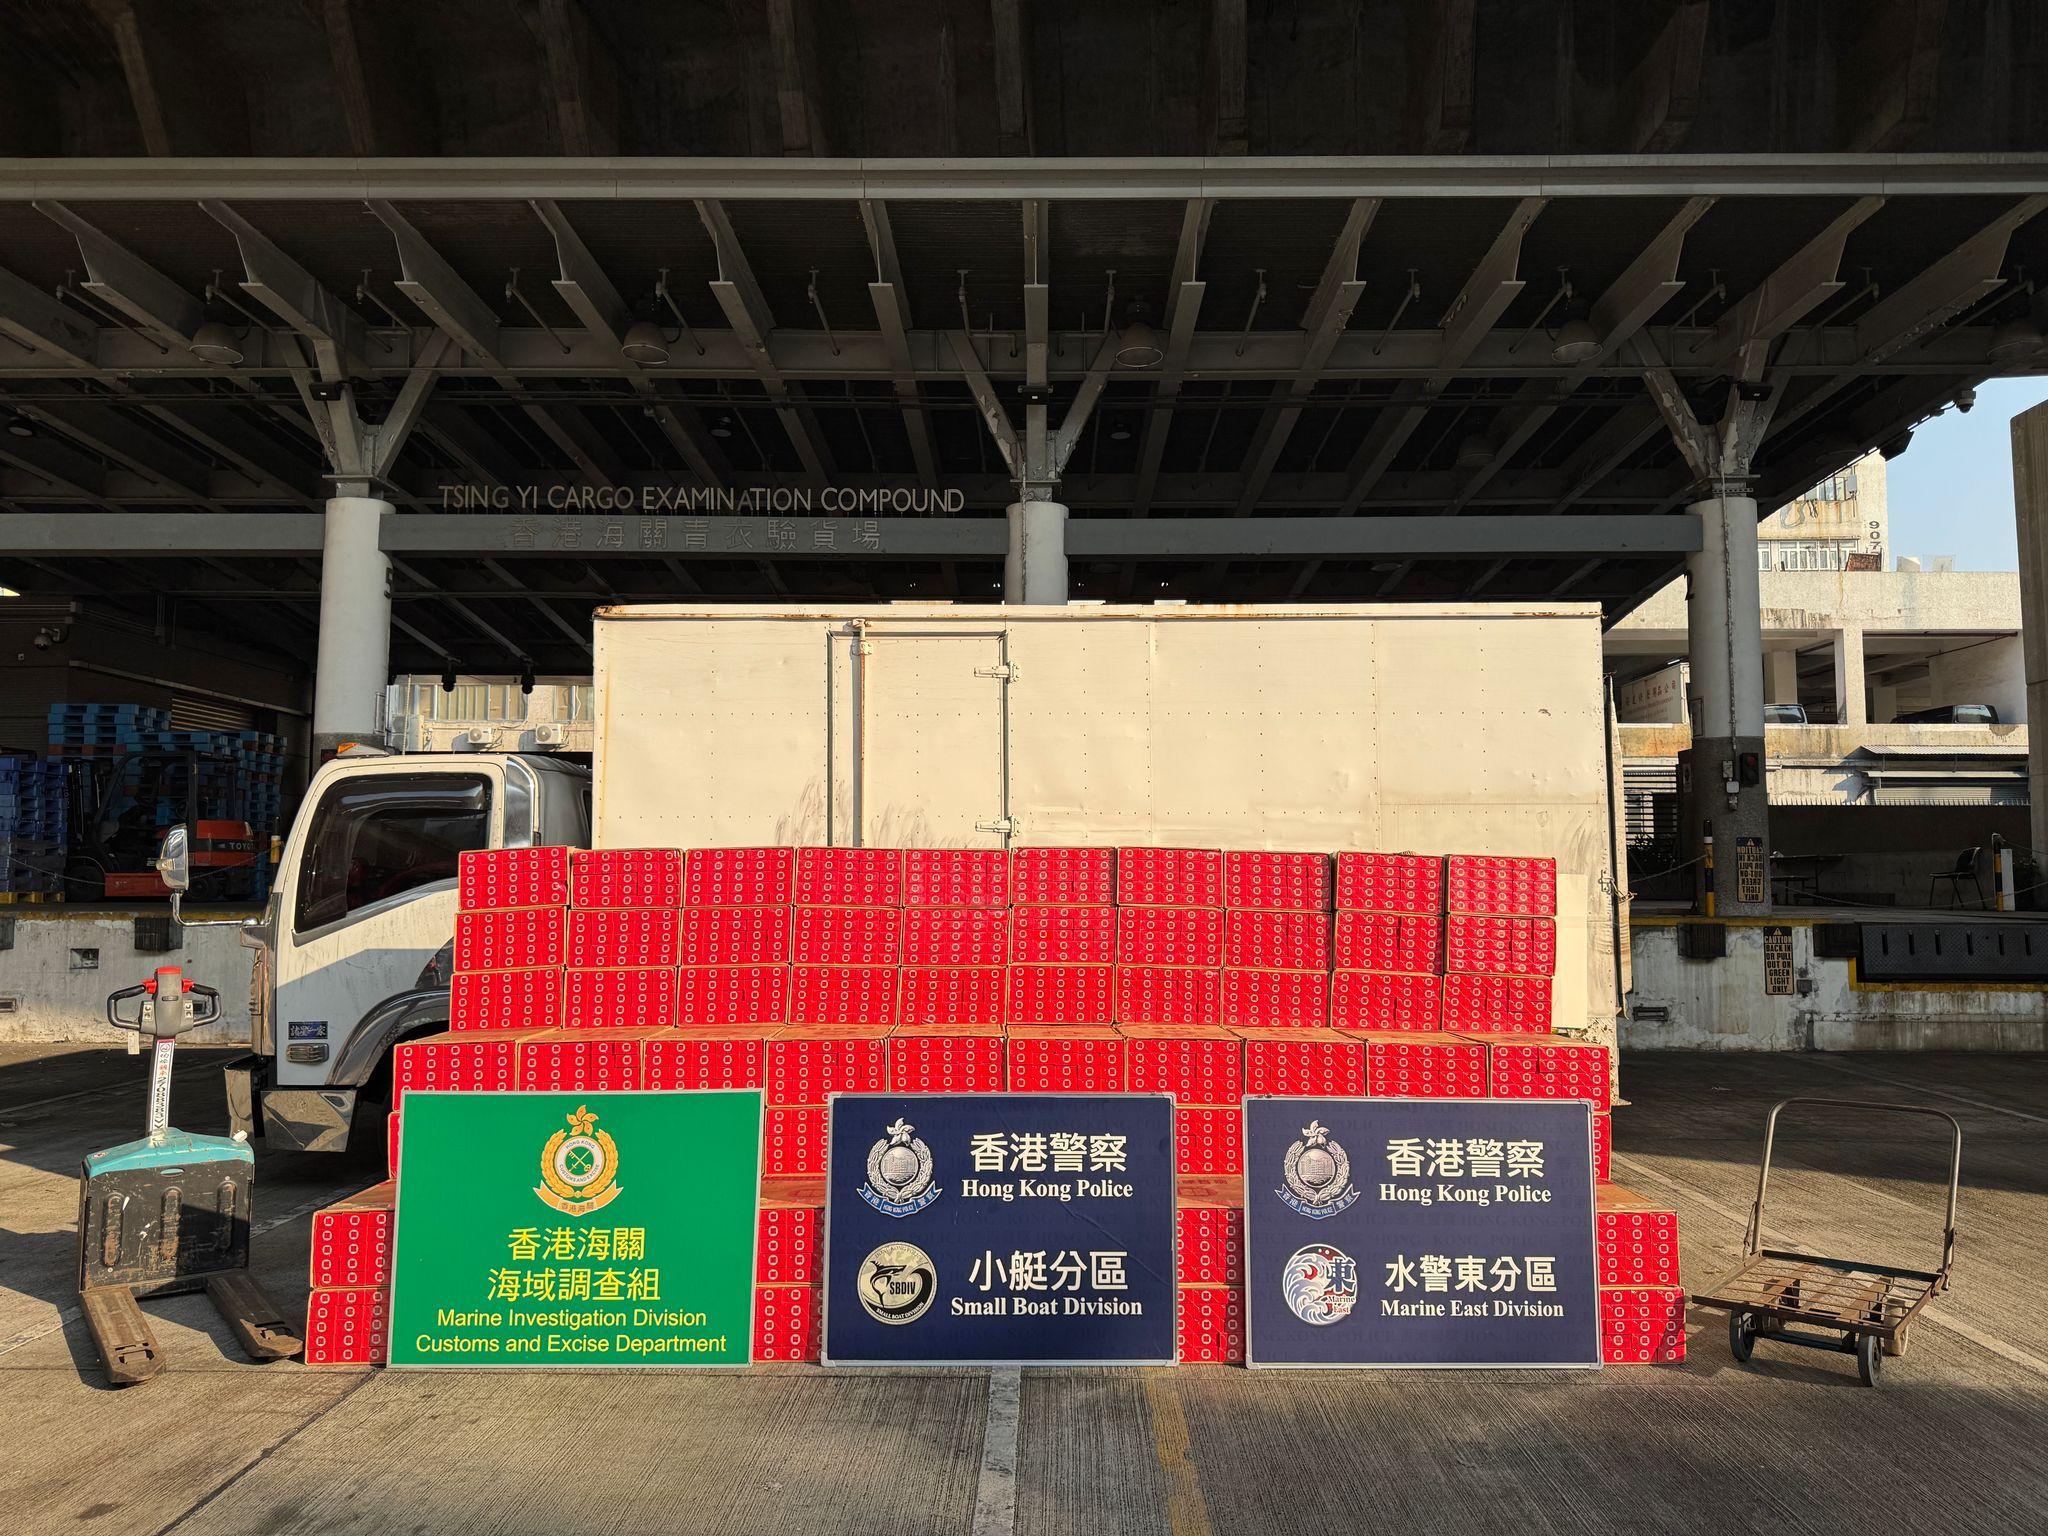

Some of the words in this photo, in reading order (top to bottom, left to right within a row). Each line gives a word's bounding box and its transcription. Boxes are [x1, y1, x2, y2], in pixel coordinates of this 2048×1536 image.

[438, 485, 509, 509] TSING
[515, 485, 538, 509] YI
[547, 486, 634, 510] CARGO
[643, 486, 811, 511] EXAMINATION
[821, 487, 964, 512] COMPOUND
[510, 518, 880, 551] 香港海關青衣驗貨場
[229, 841, 254, 850] TOYO
[1765, 935, 1793, 944] CAUTION
[1766, 944, 1783, 952] BACK
[1784, 944, 1791, 952] IN
[1766, 952, 1775, 960] OR
[1776, 952, 1792, 960] PULL
[1767, 960, 1780, 968] OUT
[1782, 960, 1791, 968] ON
[1770, 977, 1790, 985] LIGHT
[970, 1132, 1128, 1174] 香港警察
[1386, 1138, 1545, 1179] 香港警察
[961, 1179, 1014, 1201] Hong
[1019, 1179, 1071, 1201] Kong
[1077, 1179, 1133, 1198] Police
[1379, 1183, 1432, 1205] Hong
[1437, 1184, 1490, 1206] Kong
[1495, 1184, 1552, 1203] Police
[508, 1227, 646, 1261] 香港海關
[968, 1250, 1129, 1292] 小艇分區
[1384, 1255, 1557, 1293] 水警東分區
[487, 1267, 661, 1302] 海域調查組
[889, 1281, 916, 1295] SBDIV
[951, 1297, 1007, 1316] Small
[1012, 1297, 1059, 1316] Boat
[1063, 1297, 1143, 1316] Division
[1328, 1295, 1356, 1303] Marine
[1334, 1305, 1350, 1313] East
[1381, 1299, 1446, 1318] Marine
[1450, 1299, 1490, 1318] East
[1493, 1299, 1565, 1318] Division
[438, 1309, 502, 1327] Marine
[509, 1309, 627, 1331] Investigation
[634, 1309, 707, 1327] Division
[875, 1307, 892, 1319] SMALL
[416, 1335, 500, 1353] Customs
[506, 1335, 541, 1353] and
[549, 1335, 609, 1353] Excise
[616, 1335, 727, 1356] Department
